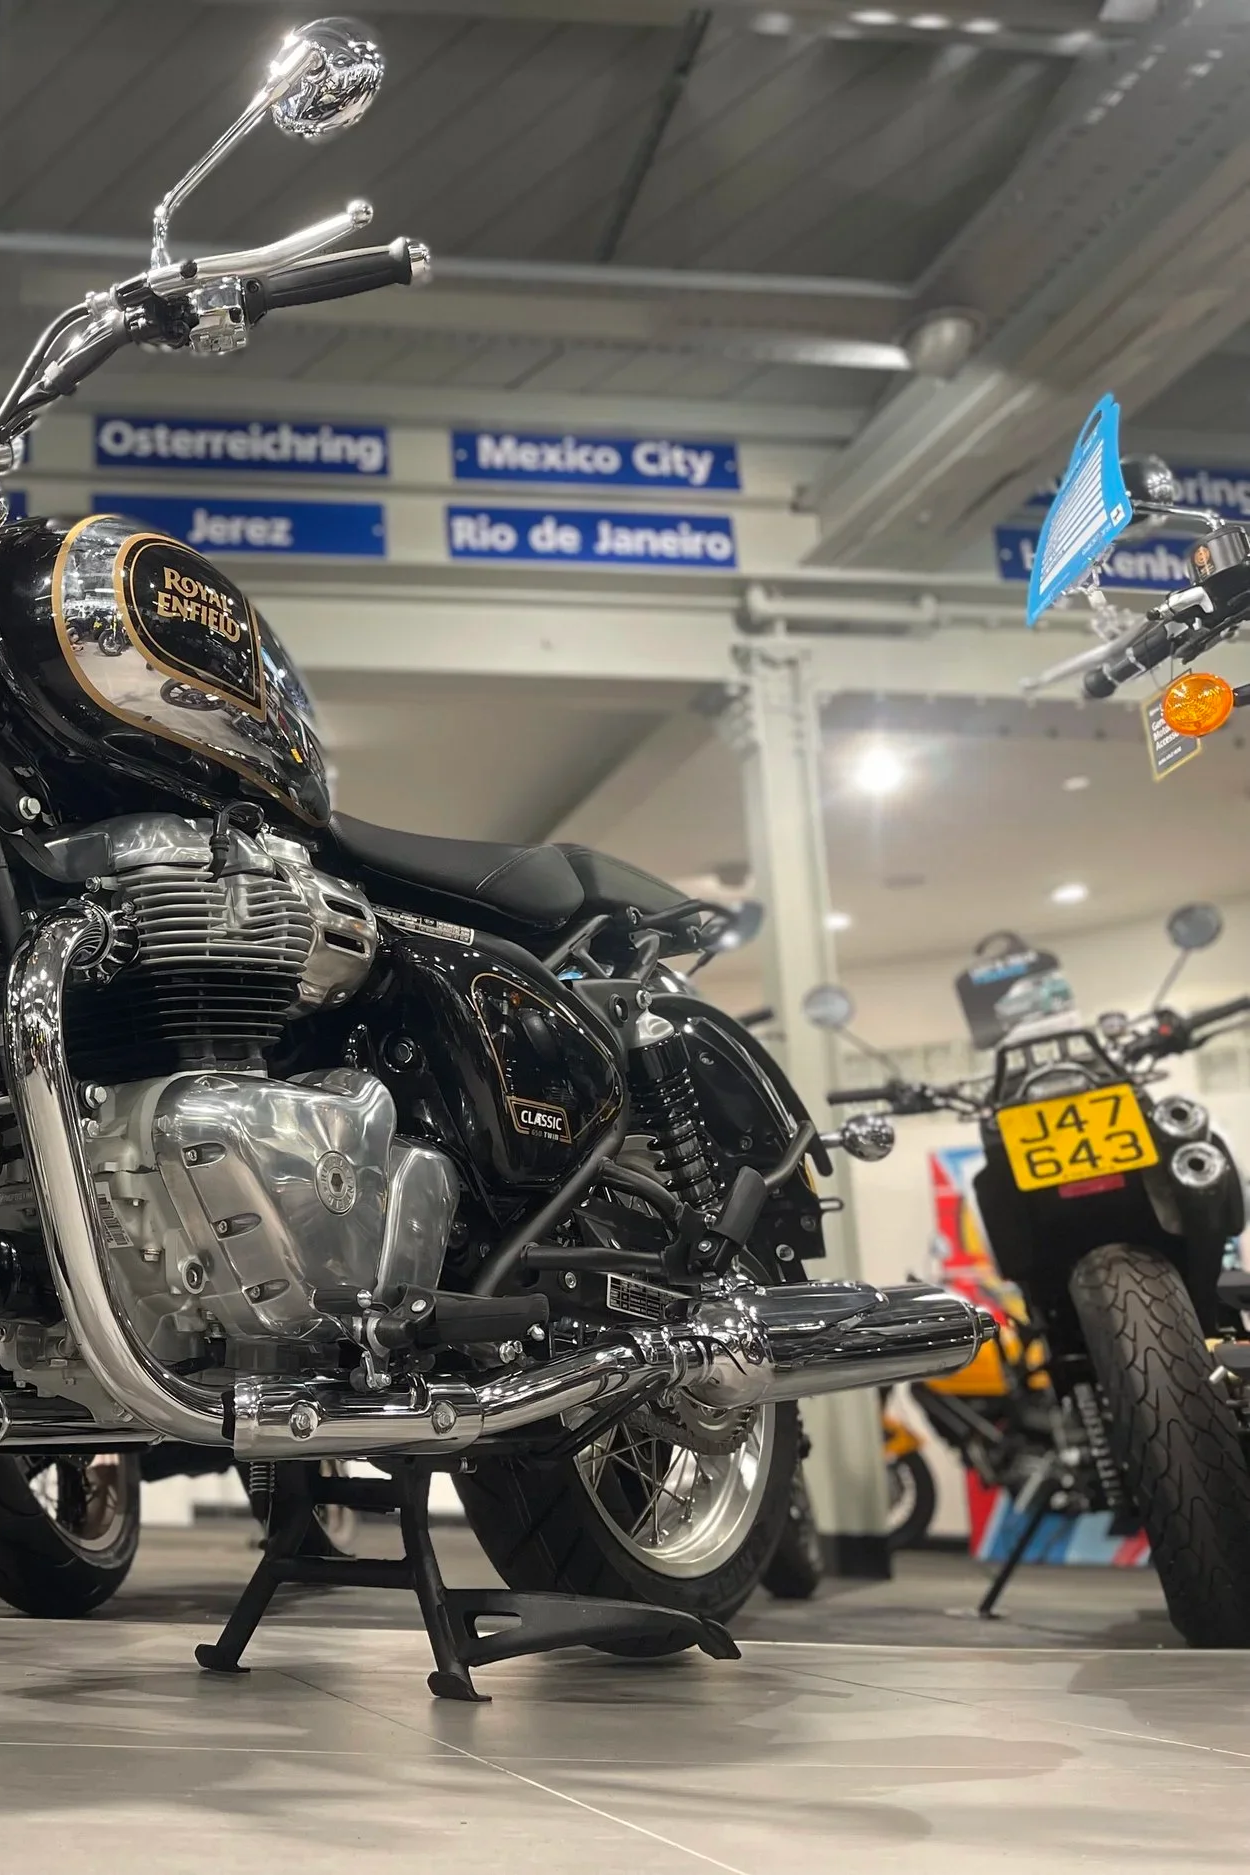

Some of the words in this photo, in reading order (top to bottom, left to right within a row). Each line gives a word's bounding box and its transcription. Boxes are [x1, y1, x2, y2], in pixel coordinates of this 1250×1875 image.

[477, 433, 621, 473] Mexico
[633, 439, 713, 486] City
[187, 508, 294, 547] Jerez
[451, 514, 517, 552] Rio
[530, 517, 579, 554] de
[593, 521, 734, 562] Janeiro
[163, 567, 234, 615] ROYAL
[156, 591, 241, 643] ENFIELD
[520, 1109, 563, 1132] CLASSIC
[1019, 1094, 1124, 1144] J47
[1025, 1129, 1145, 1180] 643
